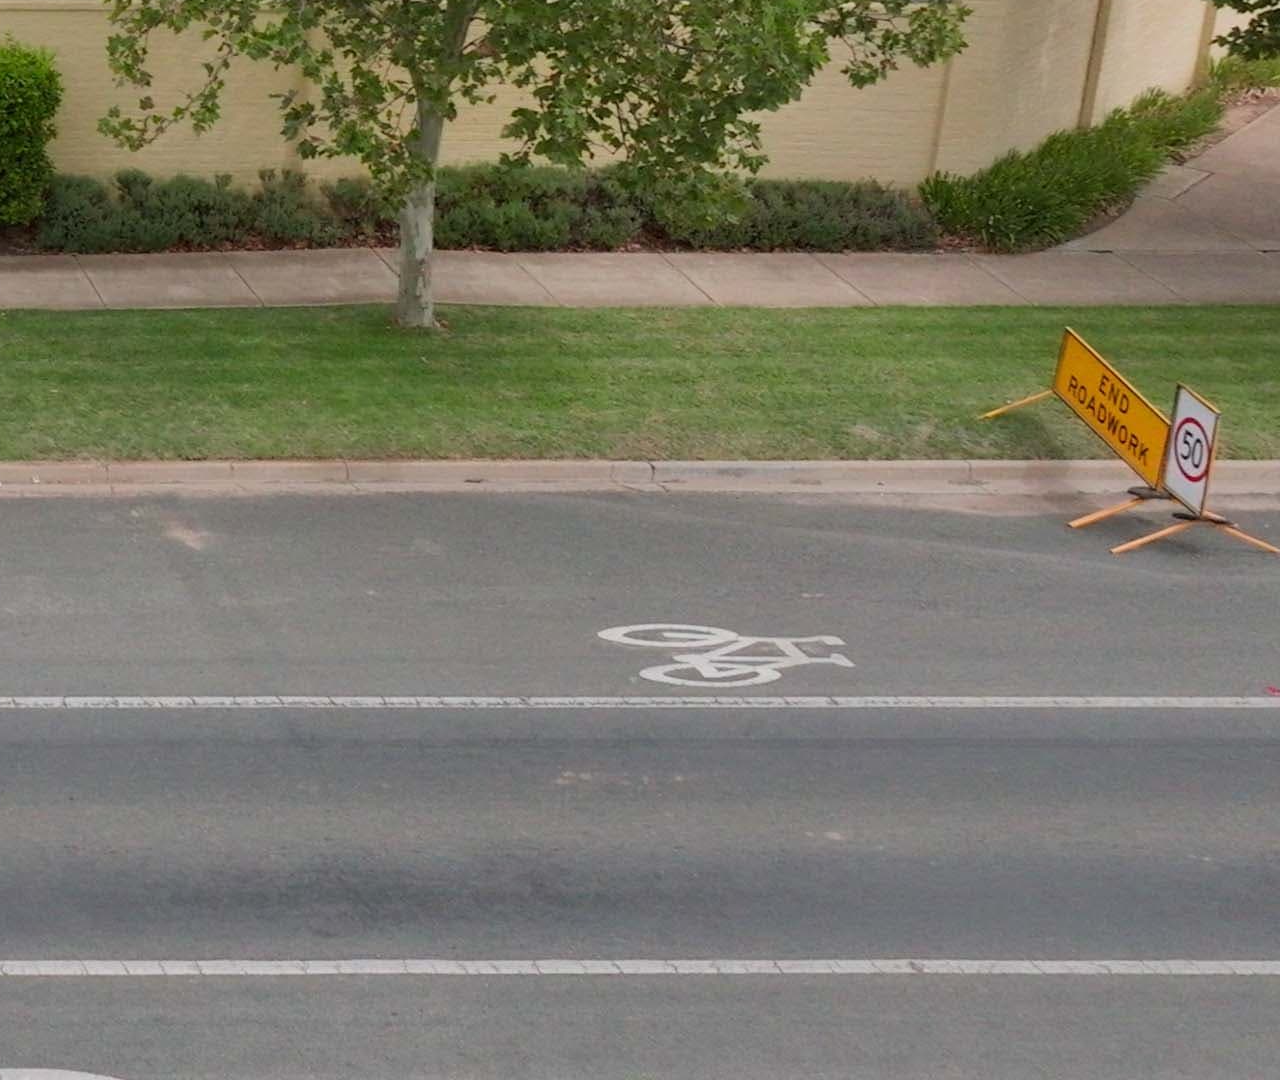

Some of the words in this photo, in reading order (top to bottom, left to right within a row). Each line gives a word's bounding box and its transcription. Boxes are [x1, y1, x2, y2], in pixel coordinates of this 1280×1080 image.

[1098, 374, 1130, 414] END
[1068, 375, 1149, 466] ROADWORK
[1180, 429, 1203, 469] 50
